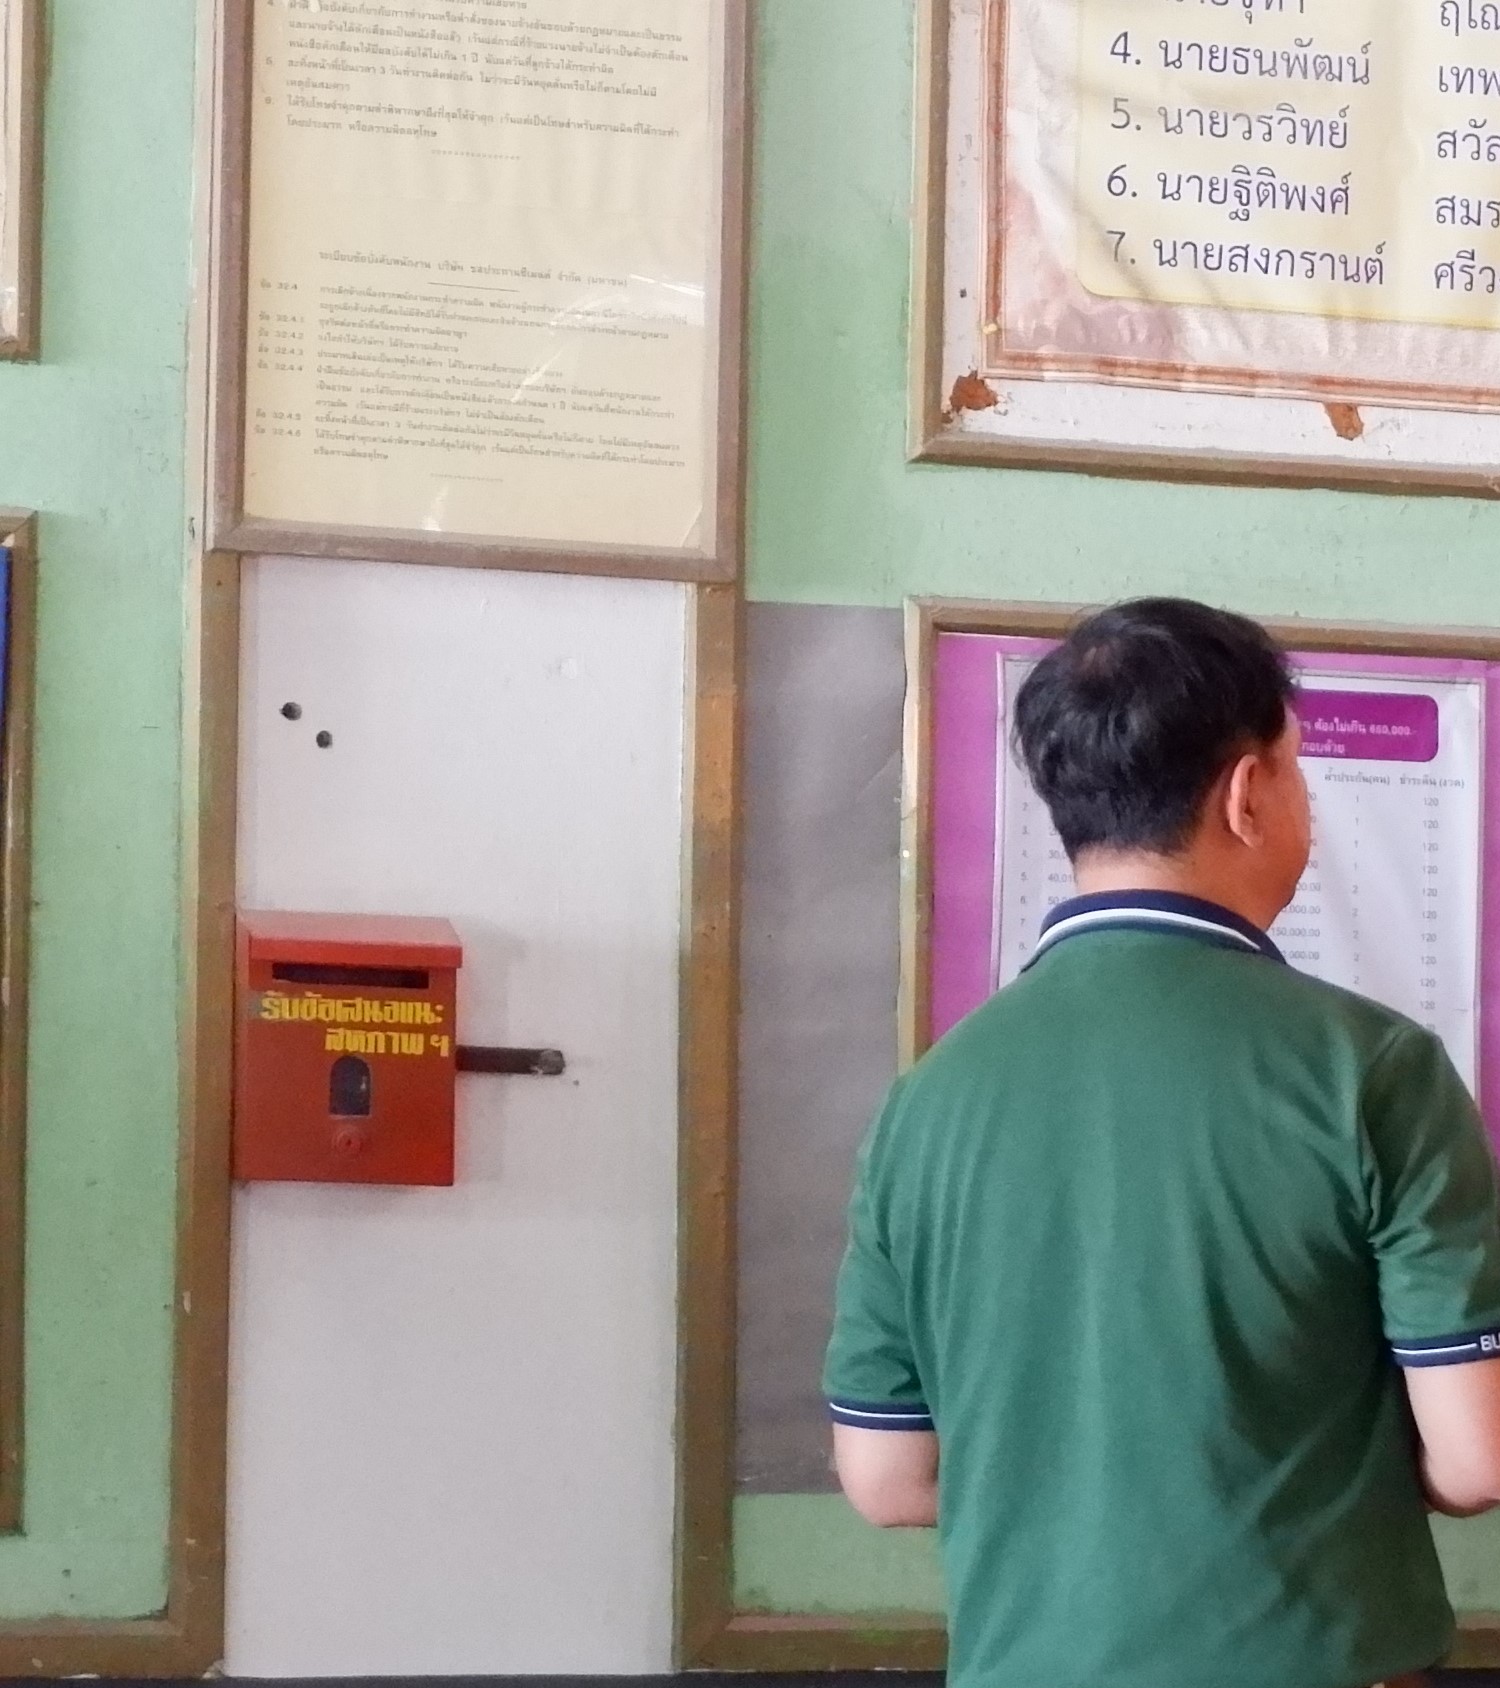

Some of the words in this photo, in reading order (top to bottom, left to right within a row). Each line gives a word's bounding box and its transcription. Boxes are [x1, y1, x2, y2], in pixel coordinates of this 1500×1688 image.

[1110, 32, 1142, 68] 4.
[1158, 38, 1372, 87] นายธนพัฒน์
[1110, 99, 1142, 132] 5.
[1157, 104, 1350, 150] นายวรวิทย์
[1106, 164, 1139, 199] 6.
[1156, 166, 1352, 221] นายฐิติพงศ์
[1153, 232, 1386, 286] นายสงกรานต์
[260, 990, 444, 1025] รับข้อเสนอแนะ
